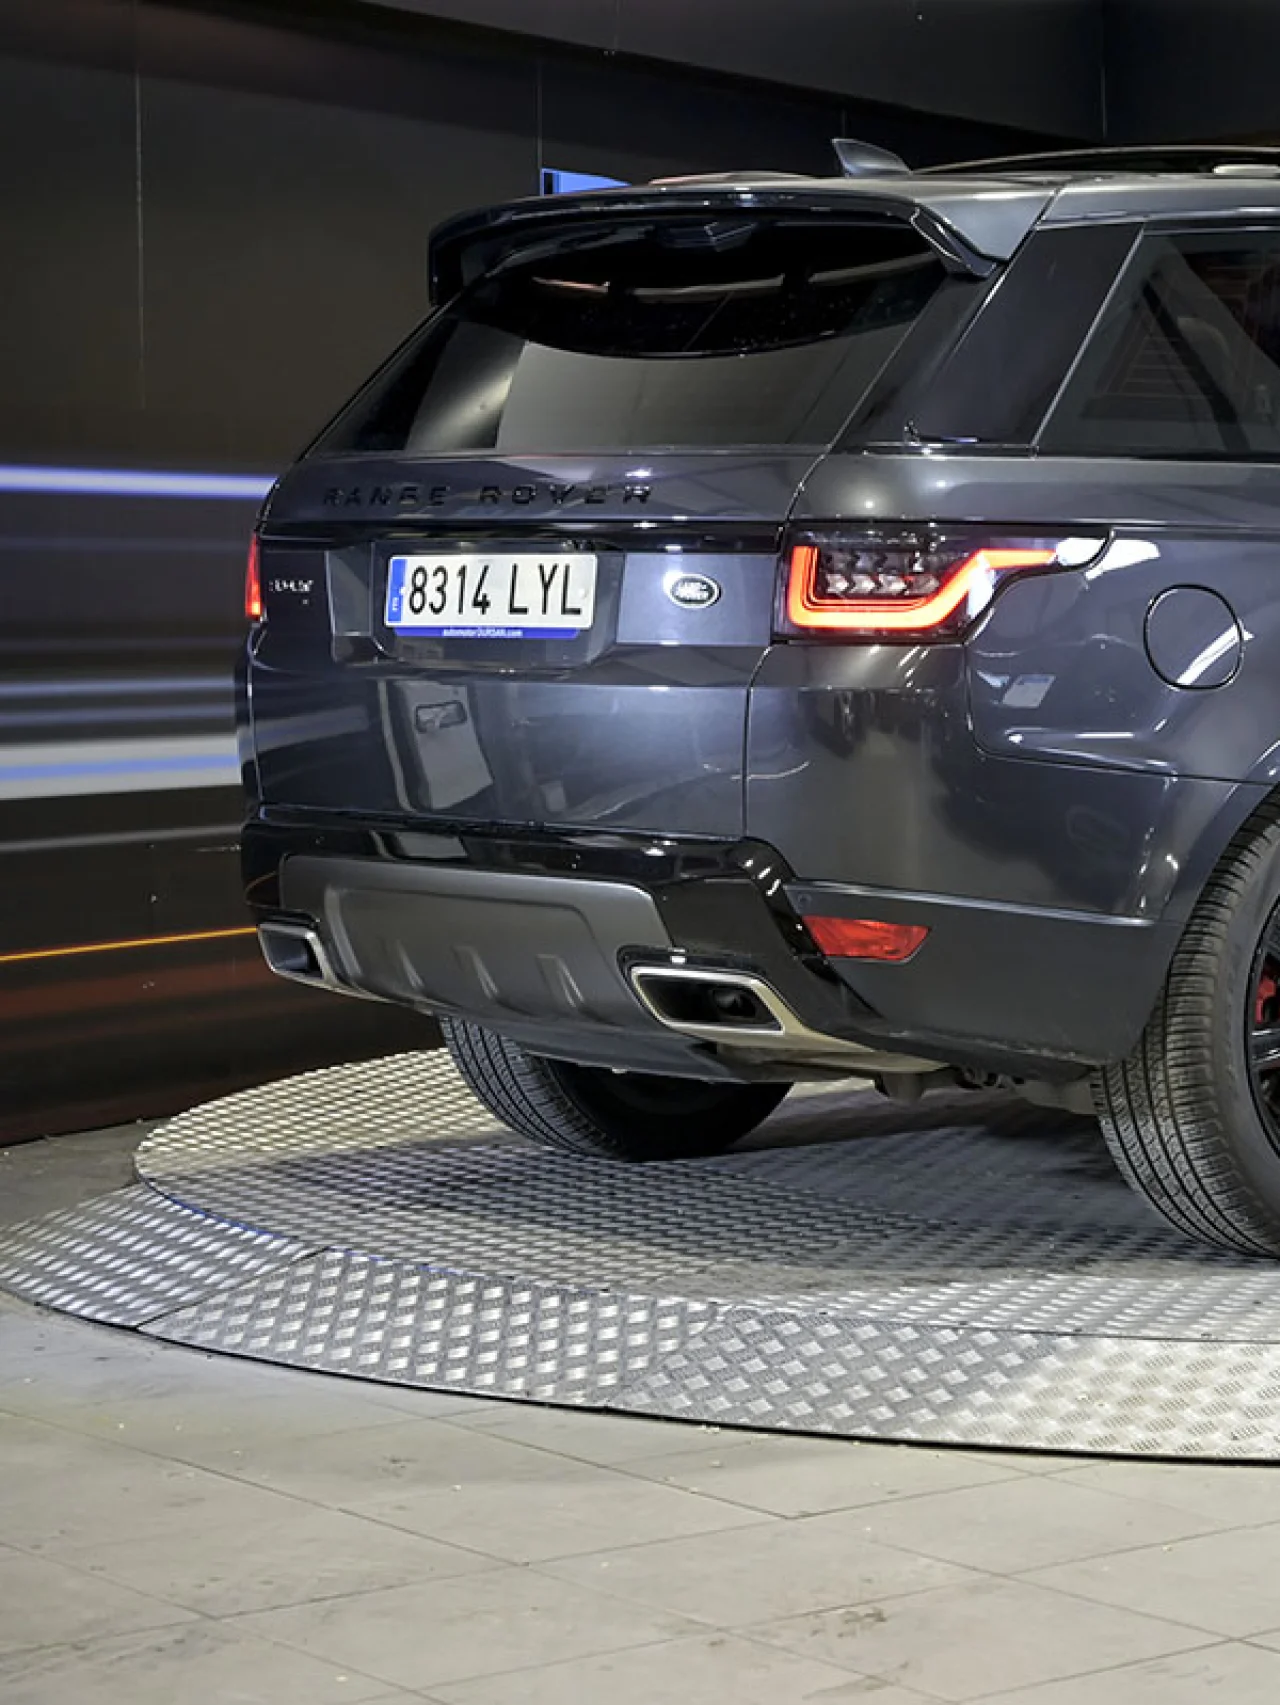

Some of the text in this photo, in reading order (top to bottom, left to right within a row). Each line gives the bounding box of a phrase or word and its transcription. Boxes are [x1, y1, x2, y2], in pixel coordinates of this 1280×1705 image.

[324, 485, 653, 506] RANGE ROVER
[409, 563, 582, 615] 8314 LYL
